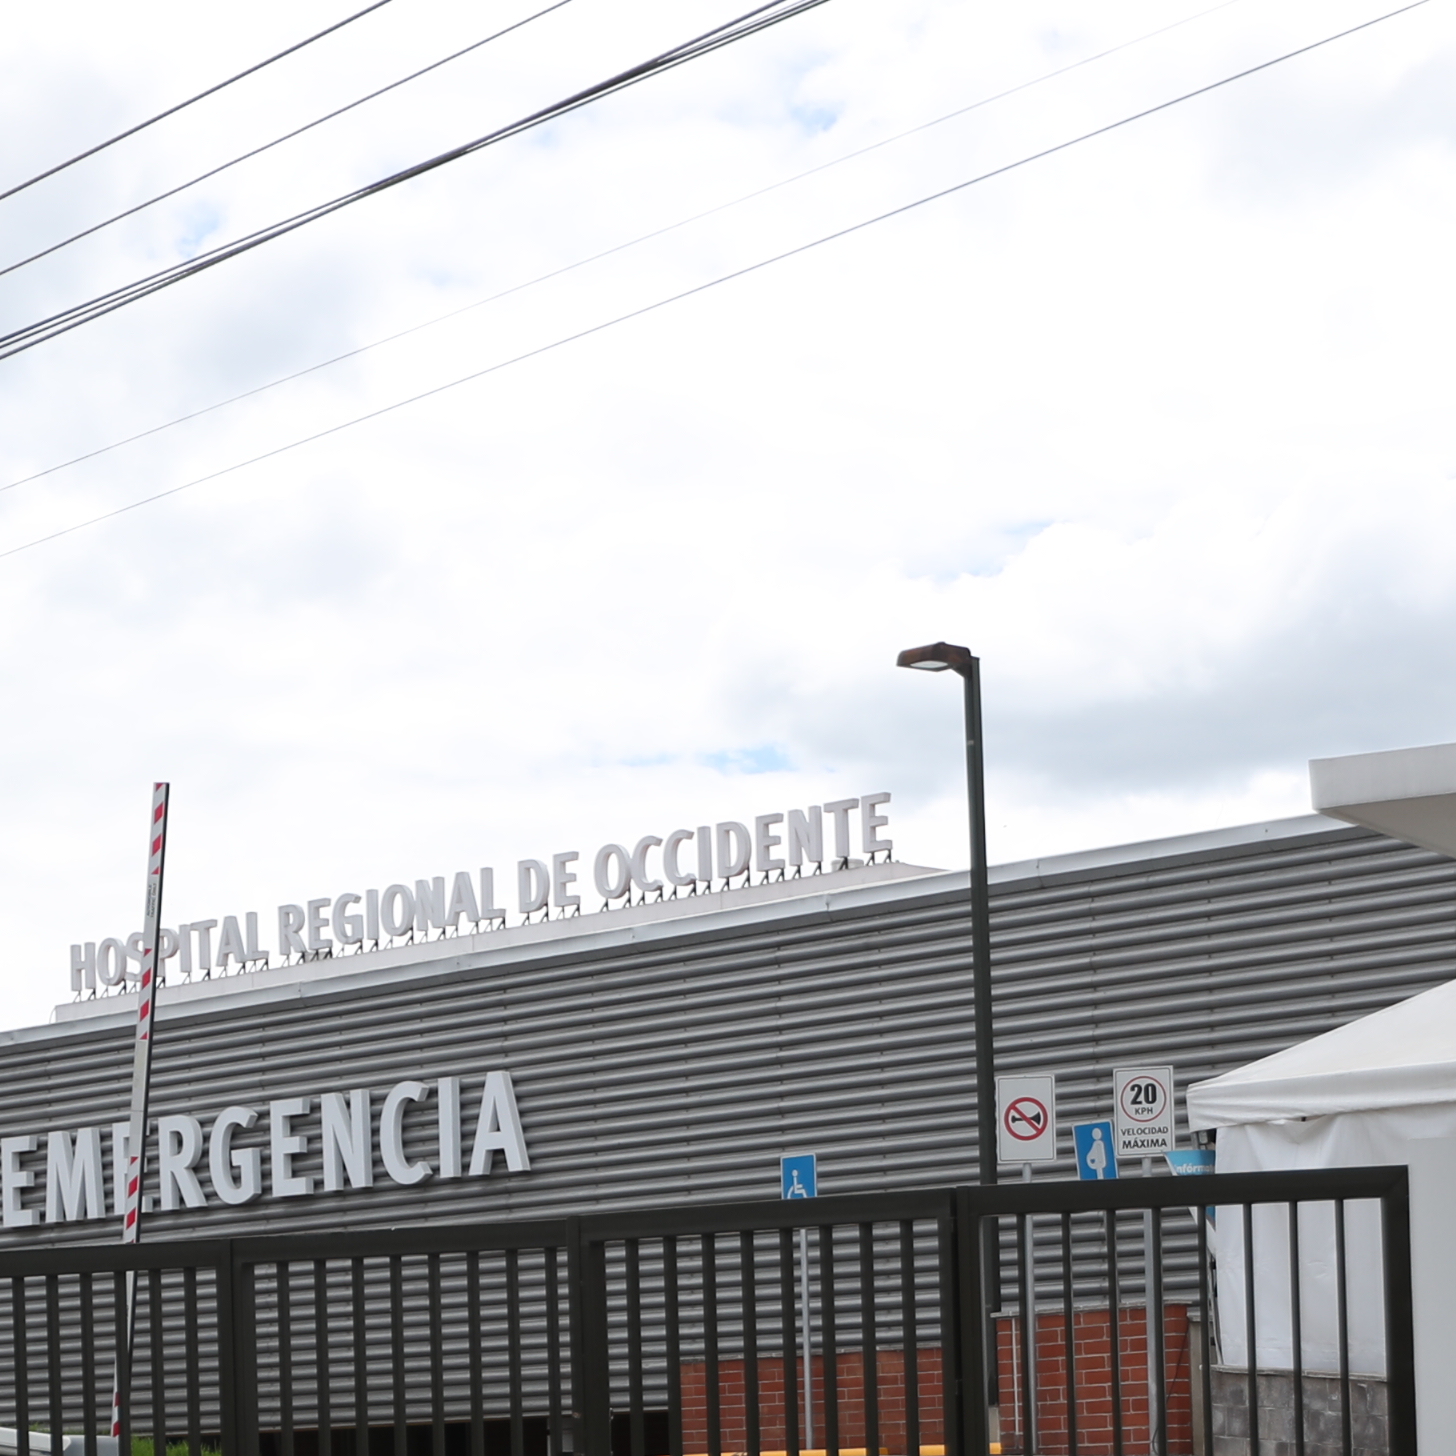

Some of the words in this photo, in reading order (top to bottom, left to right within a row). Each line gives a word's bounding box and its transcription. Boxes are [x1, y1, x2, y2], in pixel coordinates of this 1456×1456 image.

[70, 911, 270, 992] HOSPITAL
[278, 867, 506, 956] REGIONAL
[517, 851, 581, 914] DE
[594, 792, 893, 899] OCCIDENTE
[1129, 1082, 1157, 1106] 20
[1134, 1107, 1154, 1116] KPH
[1120, 1126, 1169, 1137] VELOCIDAD
[0, 1070, 531, 1228] EMERGENCIA
[1121, 1137, 1168, 1150] MÁXIMA
